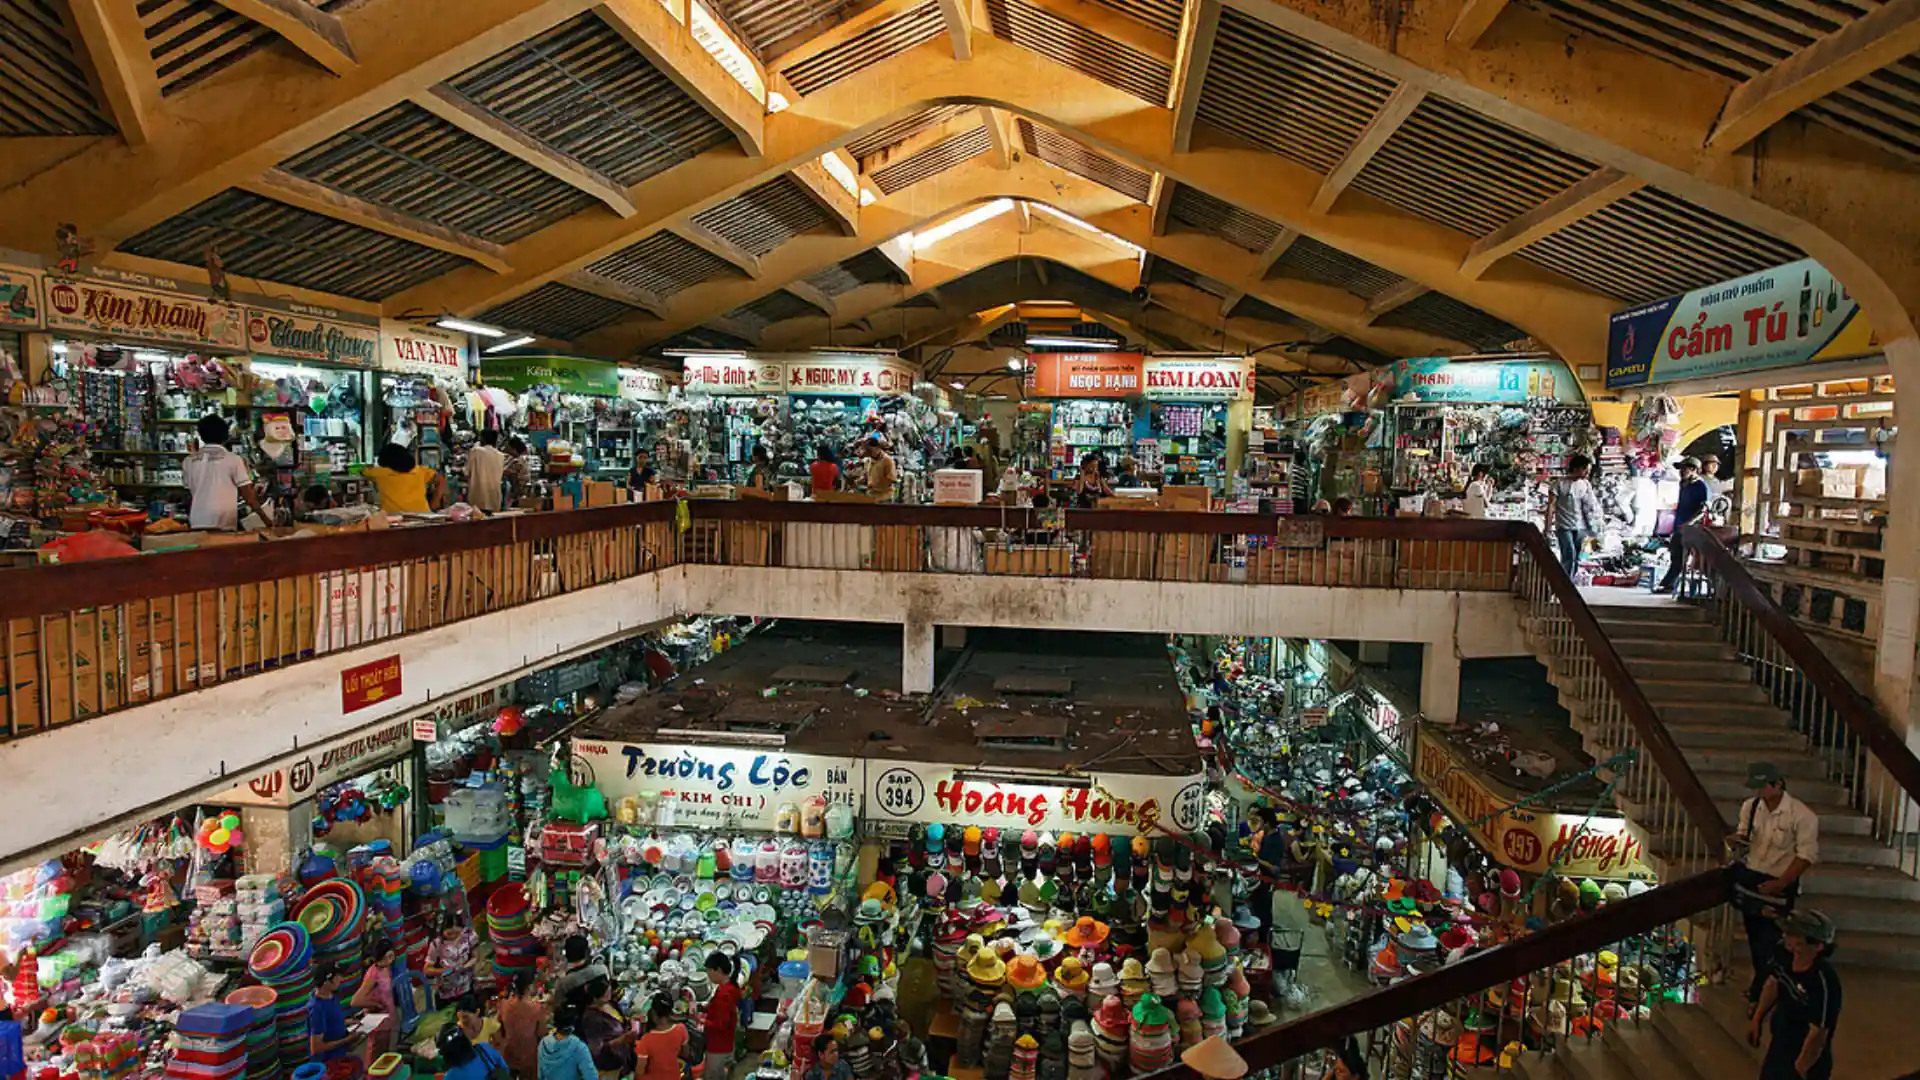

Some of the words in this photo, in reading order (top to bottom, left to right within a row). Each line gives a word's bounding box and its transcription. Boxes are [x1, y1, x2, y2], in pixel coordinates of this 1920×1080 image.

[1667, 311, 1732, 360] Cẩm
[1743, 300, 1788, 346] Tú
[1187, 370, 1242, 388] LOAN
[620, 745, 736, 790] Trường
[748, 755, 809, 792] Lộc
[680, 792, 713, 804] KIM
[886, 786, 914, 808] 394
[933, 779, 1049, 826] Hoàng
[1507, 831, 1535, 860] 395
